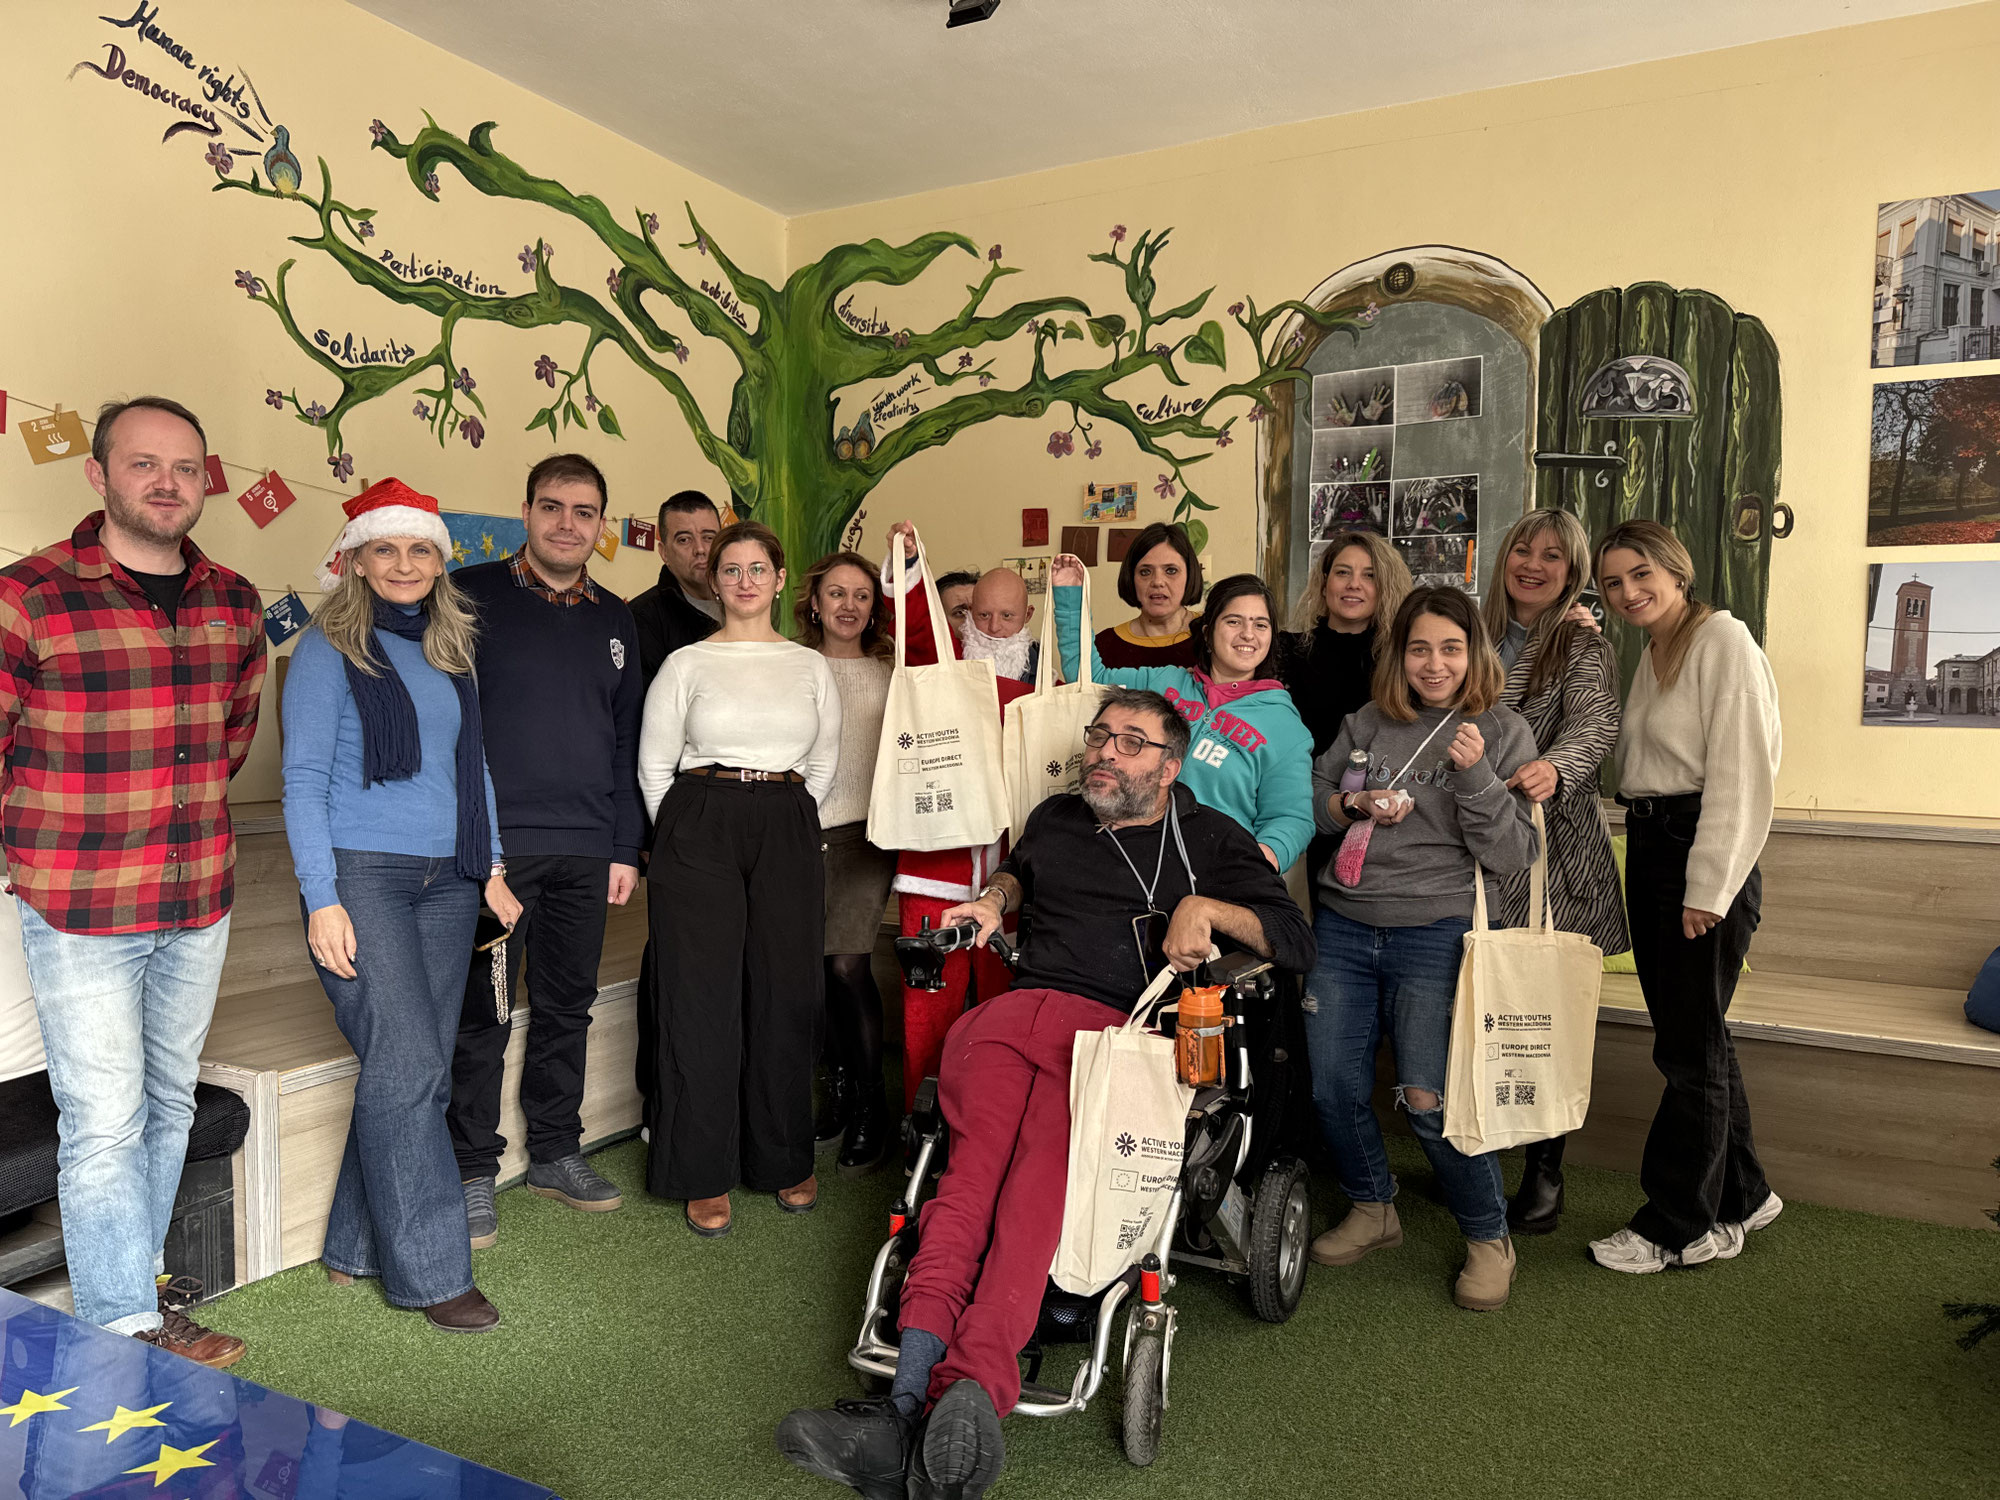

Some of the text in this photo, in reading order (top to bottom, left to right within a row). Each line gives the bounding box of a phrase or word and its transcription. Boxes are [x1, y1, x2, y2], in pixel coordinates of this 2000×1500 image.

[98, 0, 250, 119] Human rights
[66, 43, 222, 144] Democracy
[378, 249, 507, 295] Participation
[700, 279, 747, 329] mobility
[838, 294, 890, 335] diversity
[314, 329, 415, 364] Solidarity
[872, 372, 921, 414] youth work
[31, 421, 38, 432] 2
[245, 492, 254, 502] 5
[842, 509, 867, 553] logue
[916, 728, 959, 740] ACTIVE YOUTHS
[1210, 710, 1268, 753] SWEET
[921, 754, 962, 766] EUROPE DIRECT
[1192, 738, 1230, 769] 02
[1497, 1014, 1524, 1022] ACTIVE
[1501, 1043, 1552, 1051] EUROPE DIRECT
[1141, 1136, 1167, 1149] ACTIVE
[1141, 1146, 1167, 1155] WESTERN
